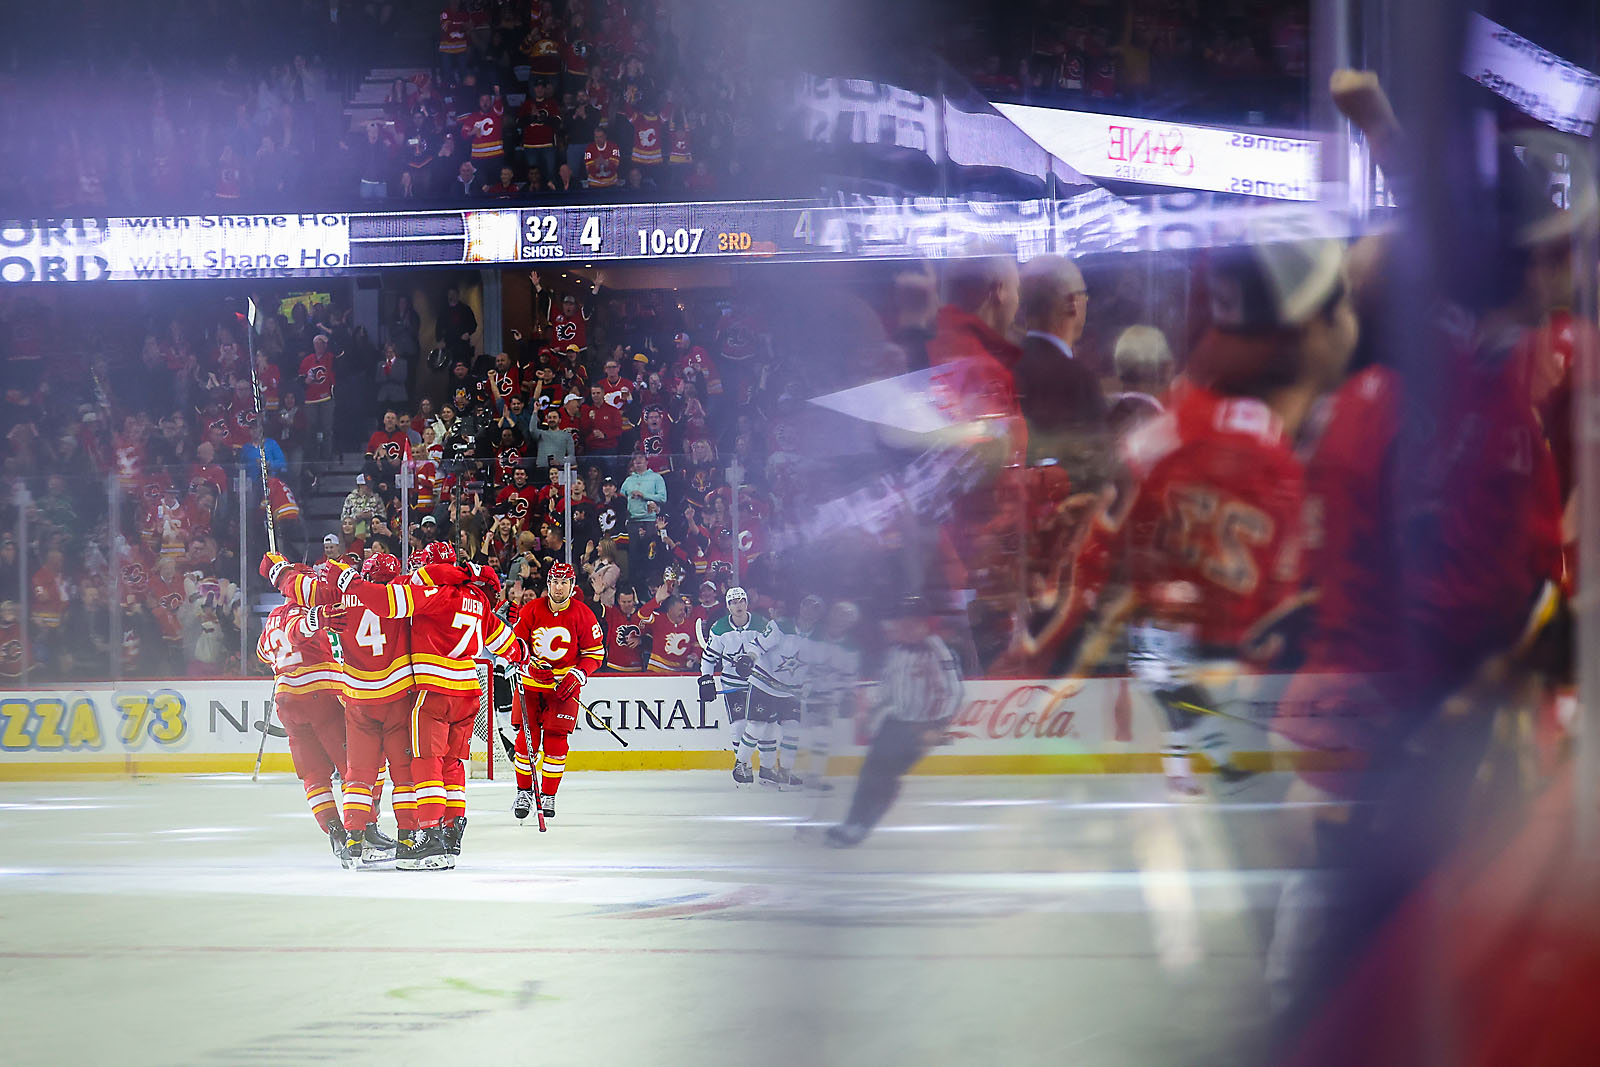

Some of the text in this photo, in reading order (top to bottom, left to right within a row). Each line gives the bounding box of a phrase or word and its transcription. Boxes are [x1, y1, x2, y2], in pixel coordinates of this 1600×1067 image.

[525, 215, 558, 243] 32
[580, 216, 602, 252] 4
[638, 228, 751, 255] 10:07 3RD
[203, 248, 289, 269] Shane
[522, 245, 564, 259] SHOTS
[355, 608, 387, 657] 4
[114, 689, 188, 747] 73
[574, 699, 719, 731] GINAL
[951, 685, 1084, 740] a-Cola
